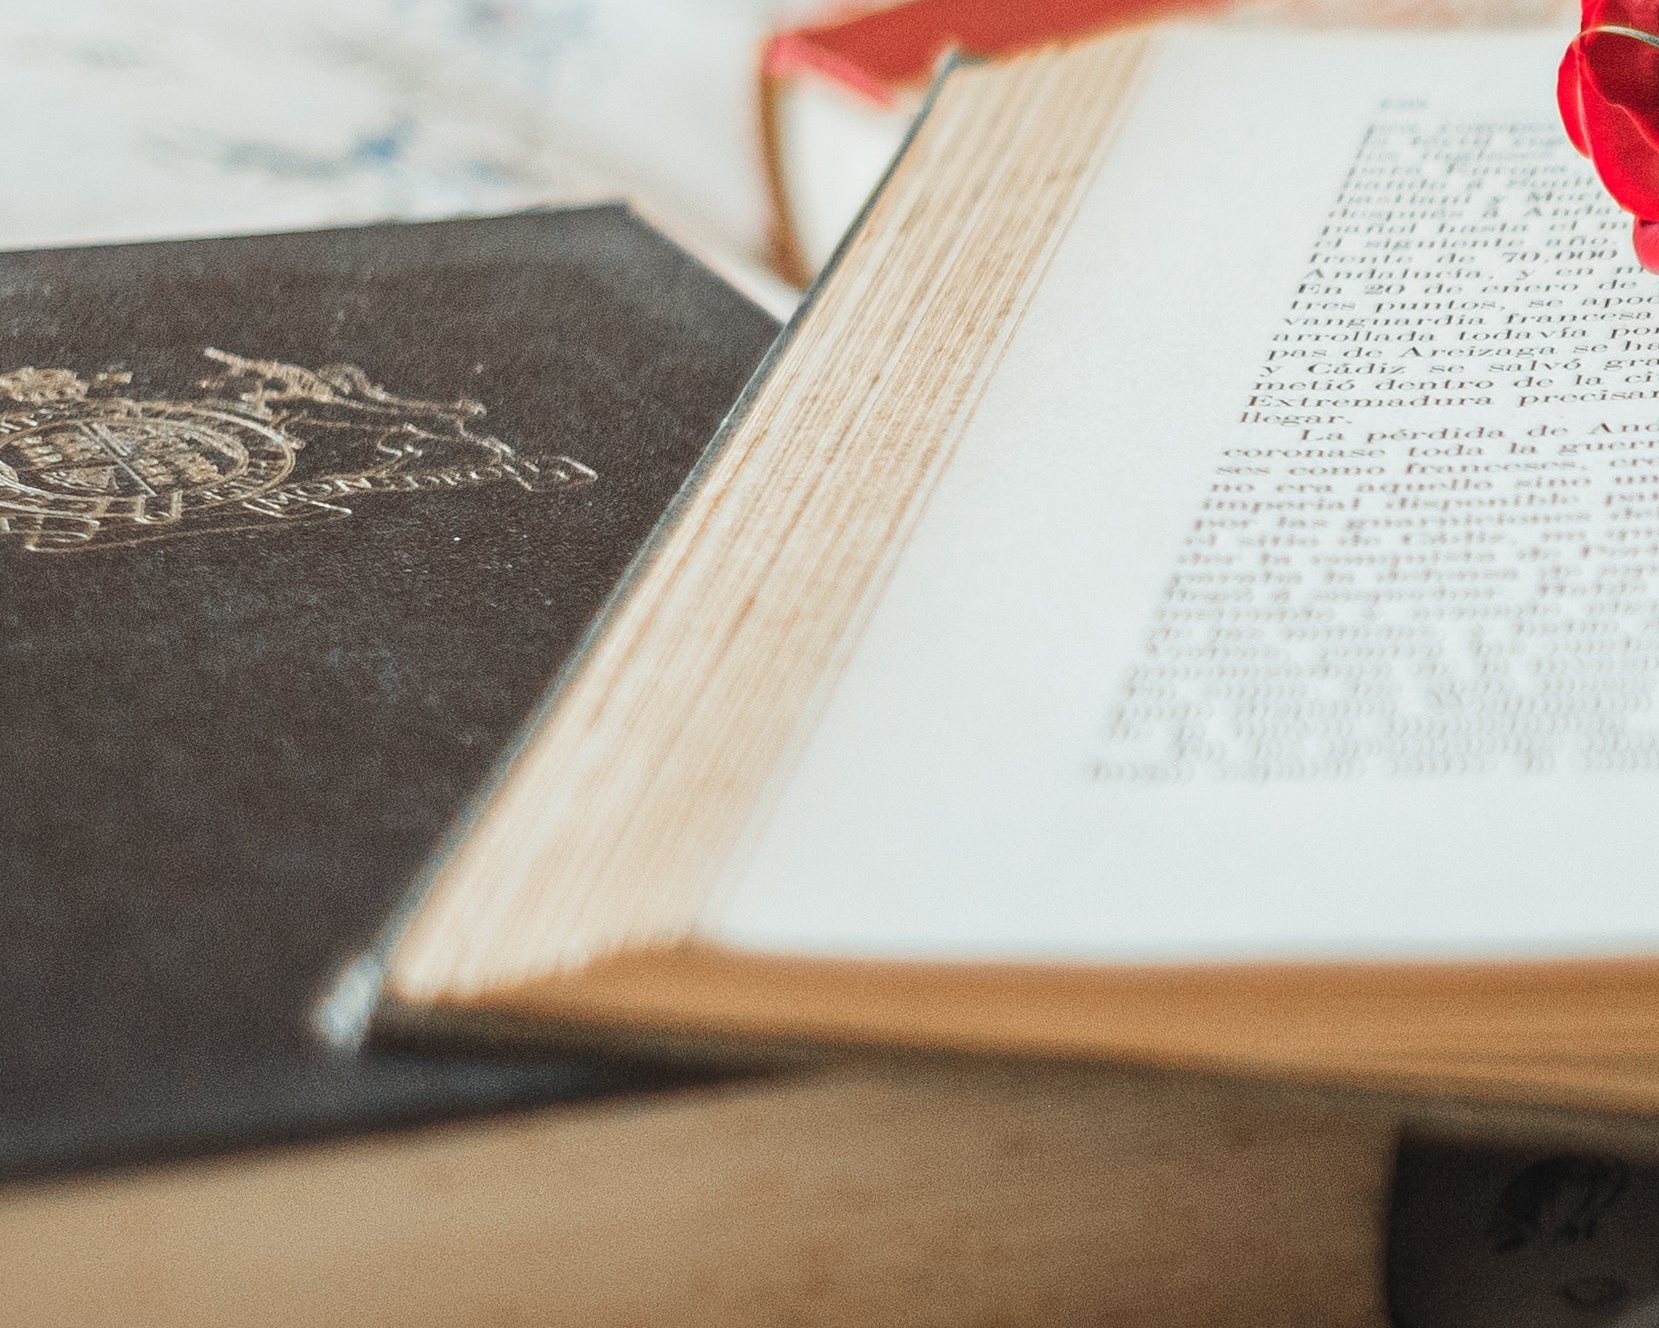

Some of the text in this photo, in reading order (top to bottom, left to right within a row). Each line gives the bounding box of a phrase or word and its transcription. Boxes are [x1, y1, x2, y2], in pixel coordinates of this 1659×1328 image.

[1290, 299, 1355, 310] tres
[1528, 299, 1563, 308] se
[1283, 311, 1652, 329] vanguardia francesa
[1272, 330, 1435, 342] arrollada
[1458, 326, 1587, 341] todavía
[1267, 349, 1327, 361] pas
[1342, 346, 1383, 358] de
[1400, 345, 1556, 358] Areizaga
[1573, 344, 1608, 353] se
[1307, 362, 1406, 375] Cádiz
[1429, 365, 1465, 373] se
[1488, 357, 1582, 372] salvó
[1254, 378, 1356, 391] metió
[1374, 378, 1494, 390] dentro
[1512, 375, 1554, 388] de
[1575, 373, 1602, 386] la
[1248, 394, 1492, 407] Extremadura
[1301, 428, 1344, 441] La
[1366, 425, 1504, 444] pérdida
[1526, 423, 1568, 437] de
[1223, 448, 1386, 458] coronase
[1407, 443, 1483, 457] toda
[1509, 441, 1537, 454] la
